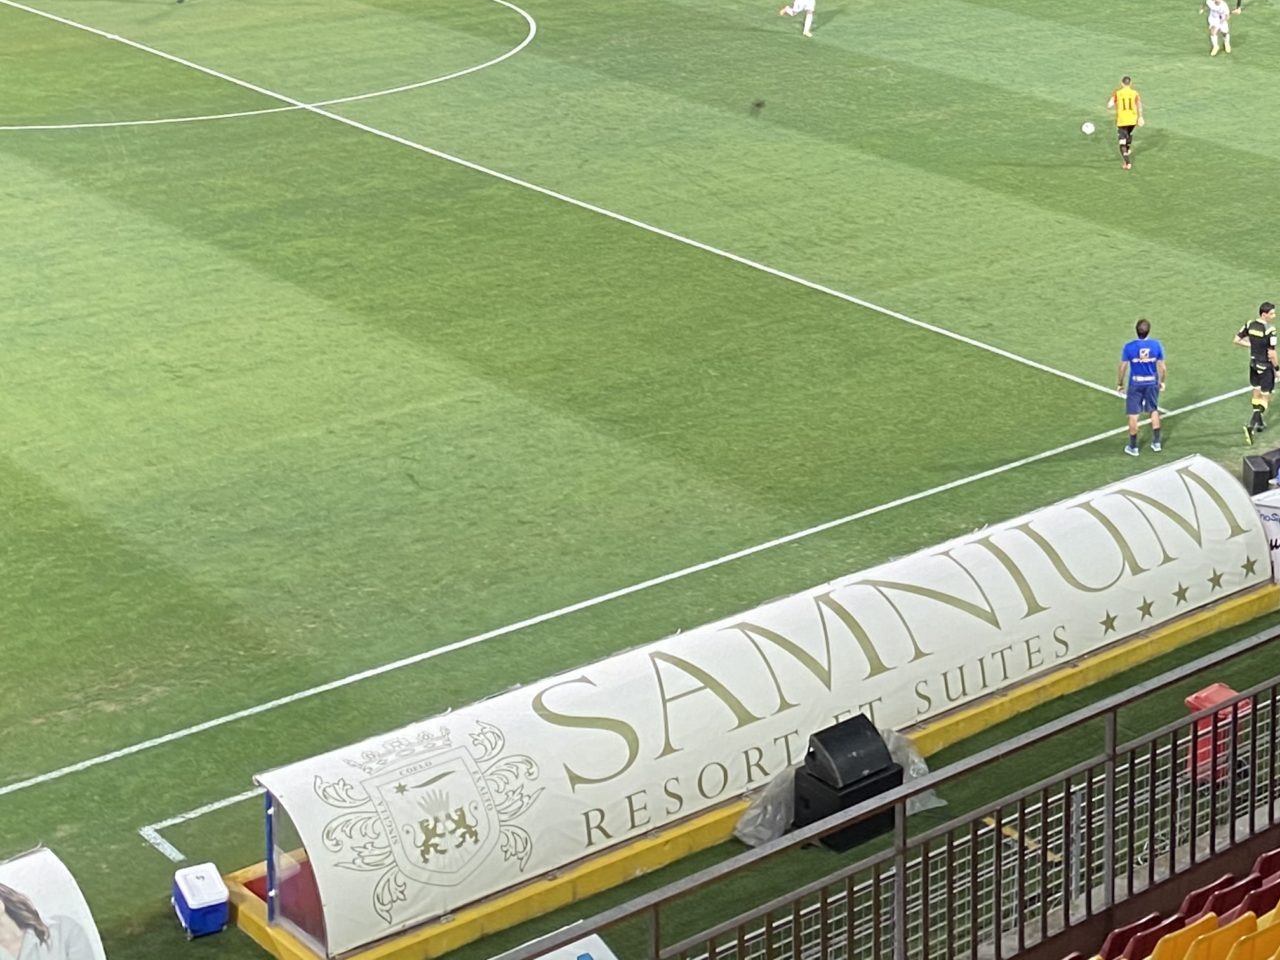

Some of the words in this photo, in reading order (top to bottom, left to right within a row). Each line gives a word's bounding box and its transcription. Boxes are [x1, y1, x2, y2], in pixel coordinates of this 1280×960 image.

[1122, 97, 1133, 111] 11
[532, 465, 1252, 792] SAMNIUM
[581, 728, 801, 847] RESORT
[915, 625, 1071, 715] SUITES
